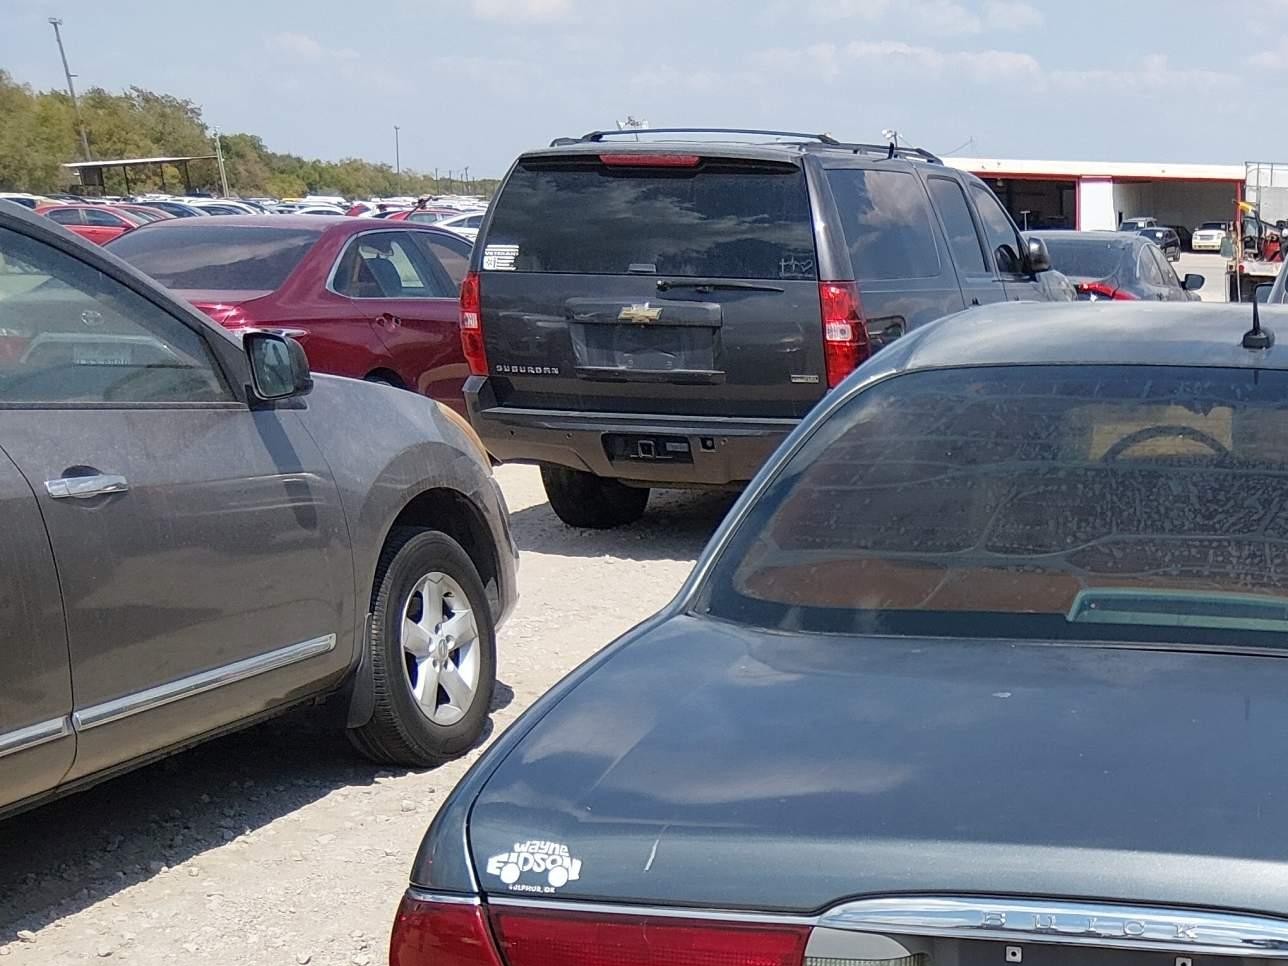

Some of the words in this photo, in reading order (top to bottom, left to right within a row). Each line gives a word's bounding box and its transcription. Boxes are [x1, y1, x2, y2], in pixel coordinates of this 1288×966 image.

[495, 364, 559, 375] SUBURBAN
[544, 886, 556, 894] OK
[981, 911, 1198, 939] BUICK
